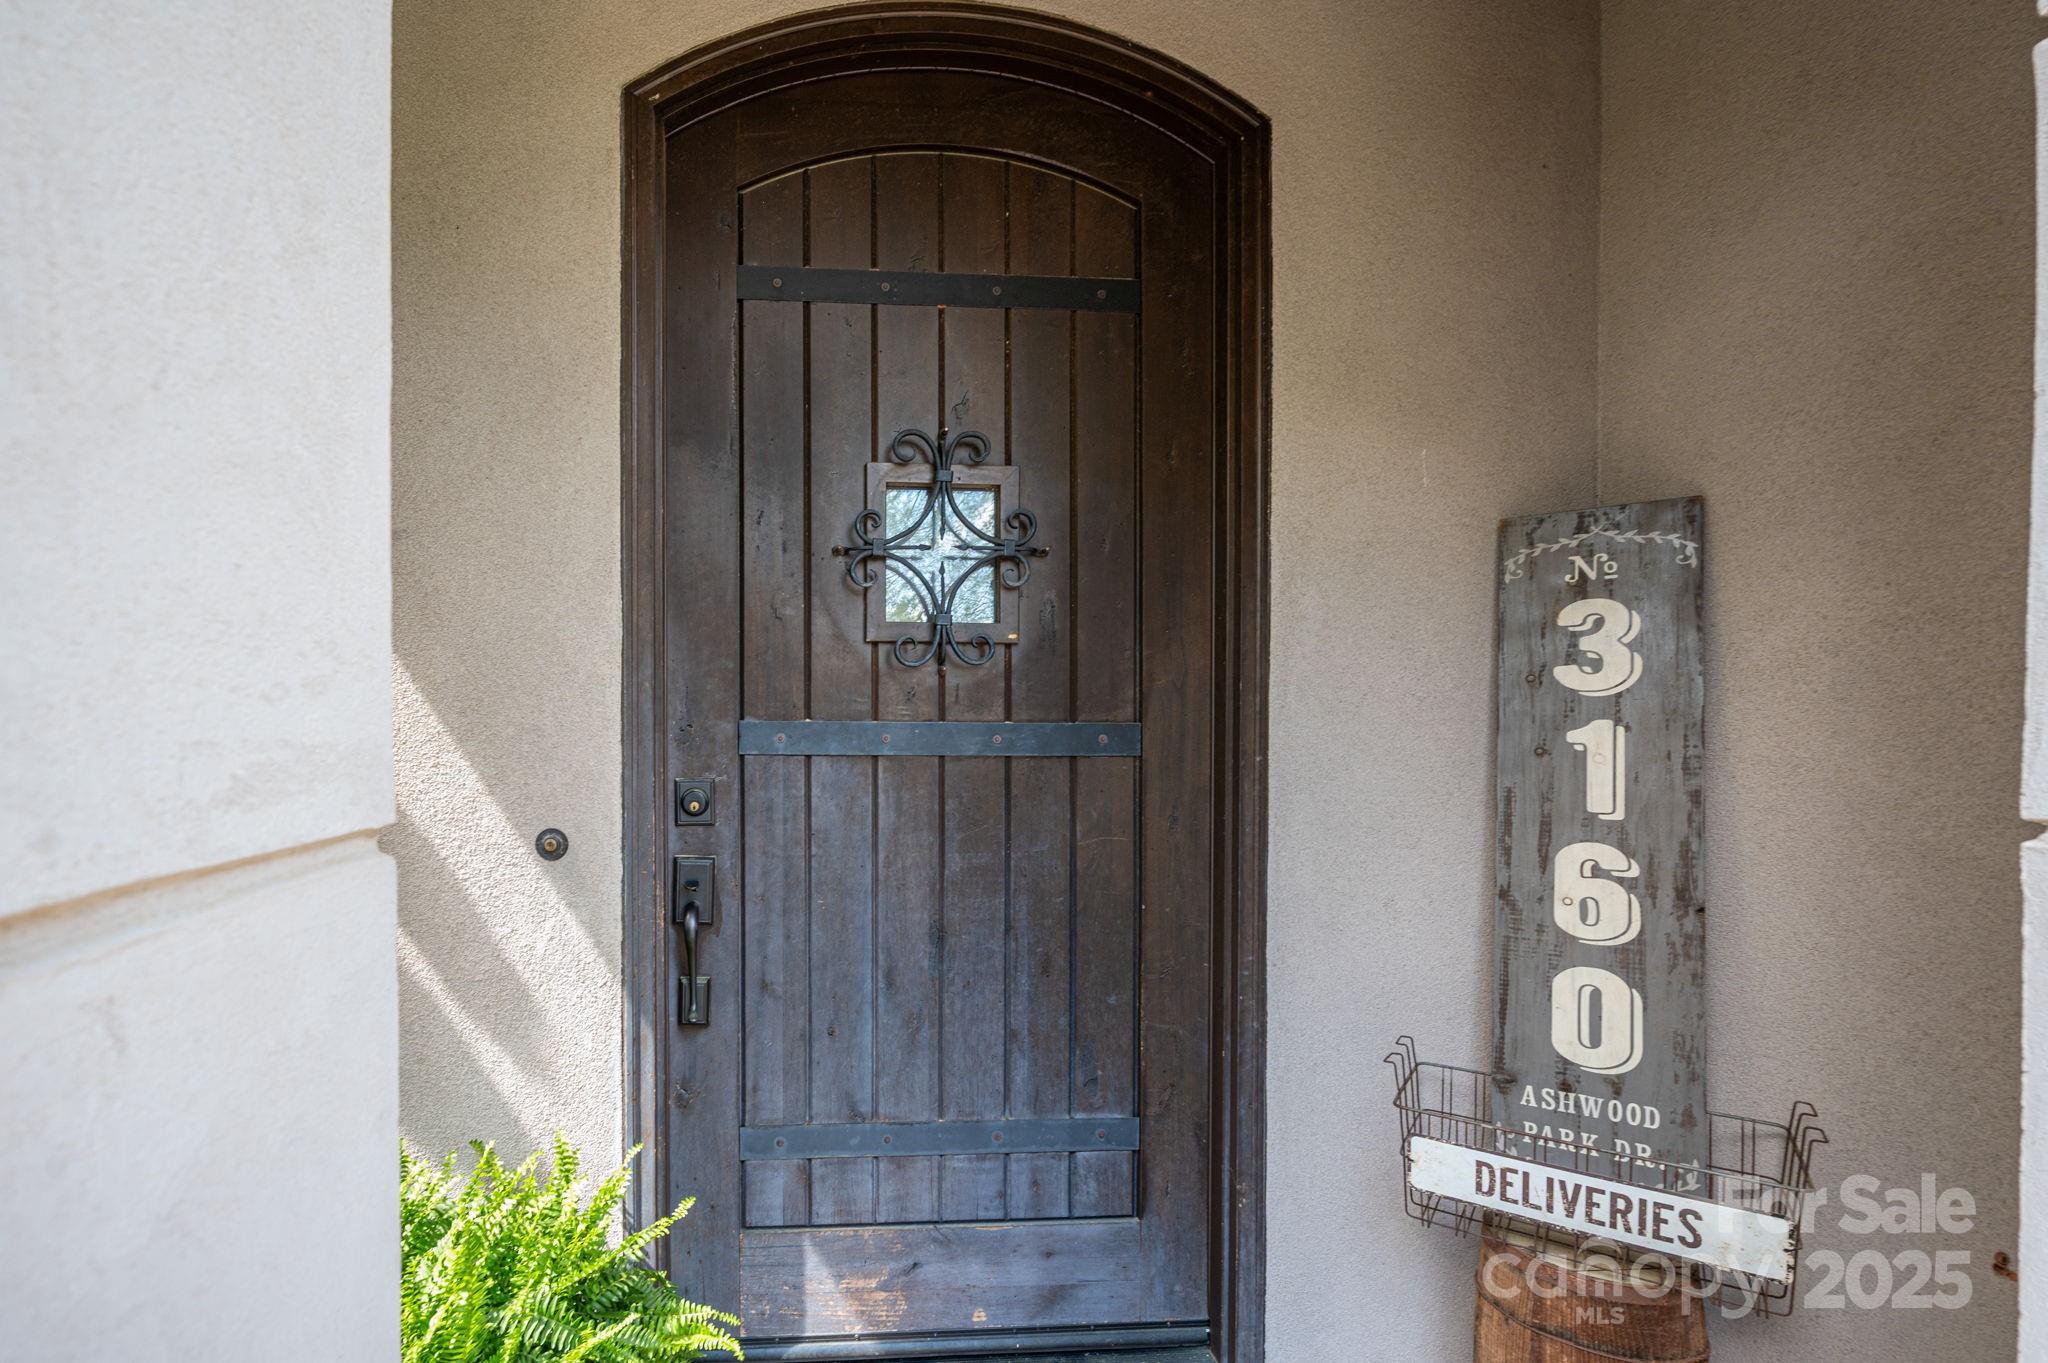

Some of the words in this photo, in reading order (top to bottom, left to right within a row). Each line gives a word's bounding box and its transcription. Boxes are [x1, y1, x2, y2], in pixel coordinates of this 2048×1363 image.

[1520, 1085, 1661, 1129] ASHWOOD
[1522, 1121, 1599, 1157] PARK
[1475, 1160, 1703, 1249] DELIVERIES
